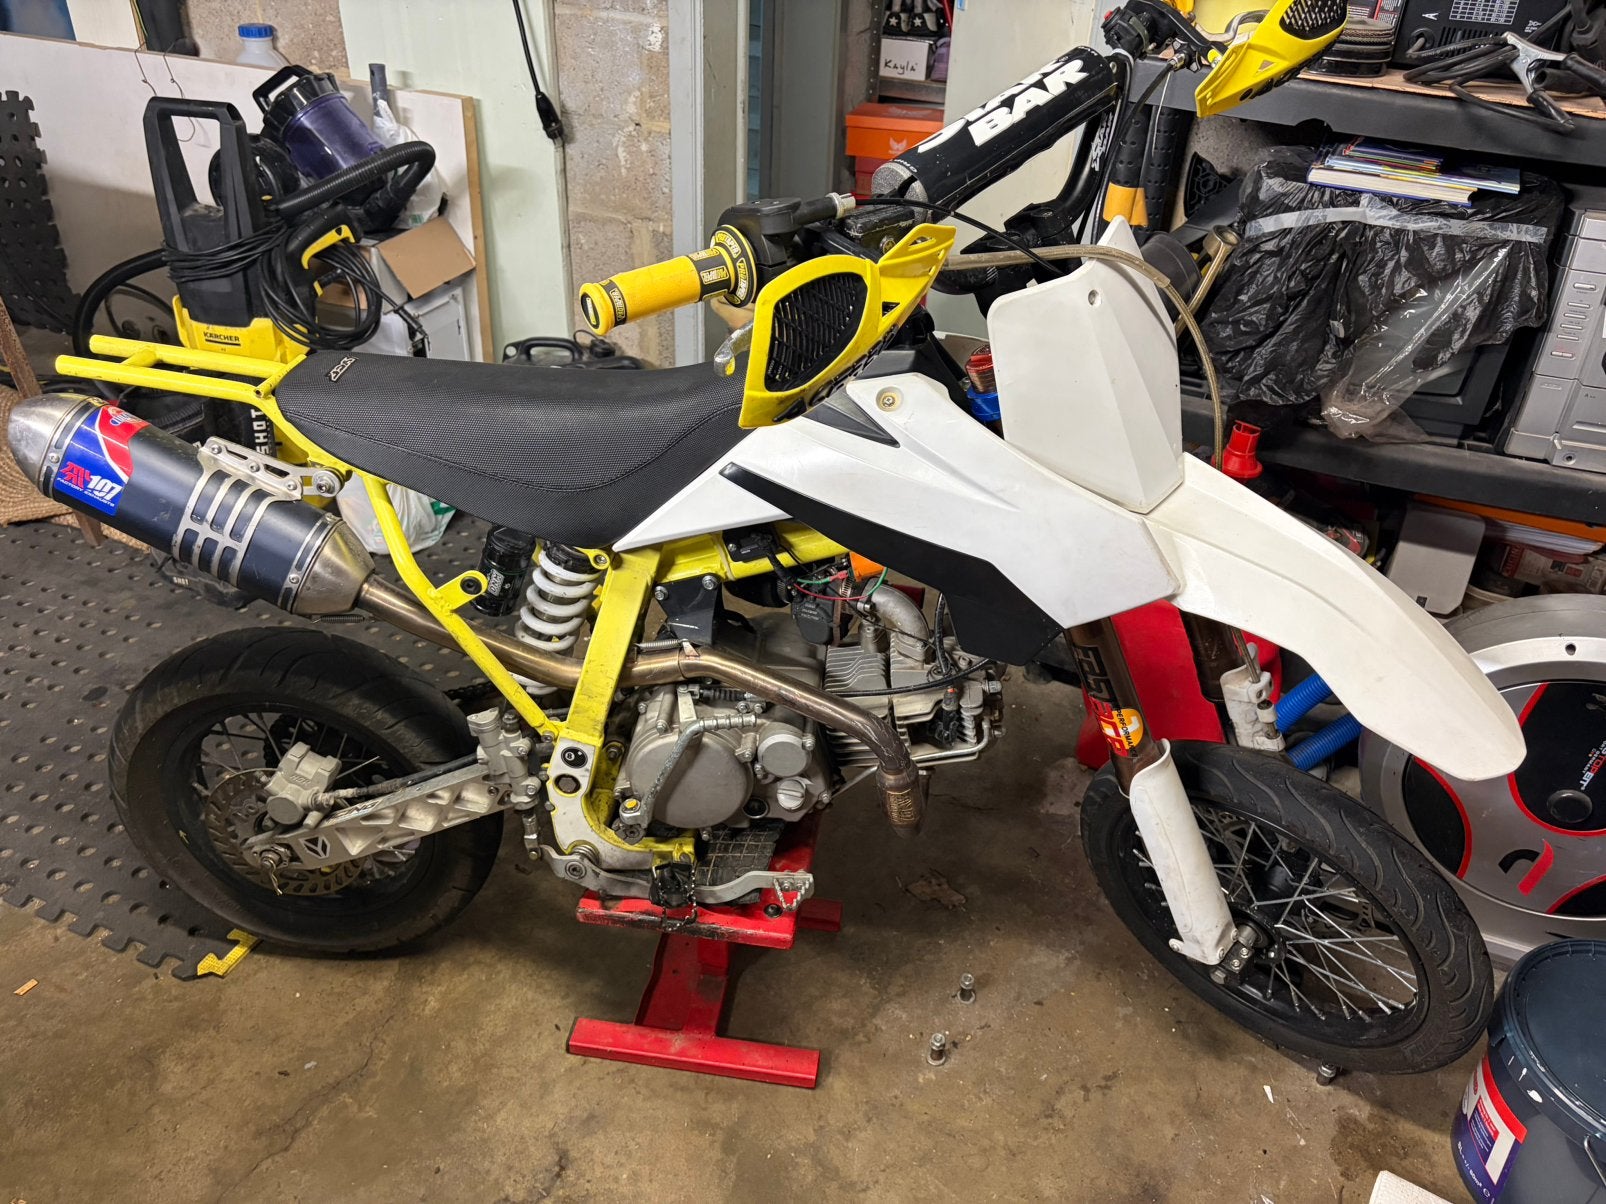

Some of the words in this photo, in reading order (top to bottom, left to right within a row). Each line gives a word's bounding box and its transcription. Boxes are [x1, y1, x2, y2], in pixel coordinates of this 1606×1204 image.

[884, 59, 917, 75] Kayla
[967, 59, 1089, 147] BAR
[87, 475, 123, 501] 107
